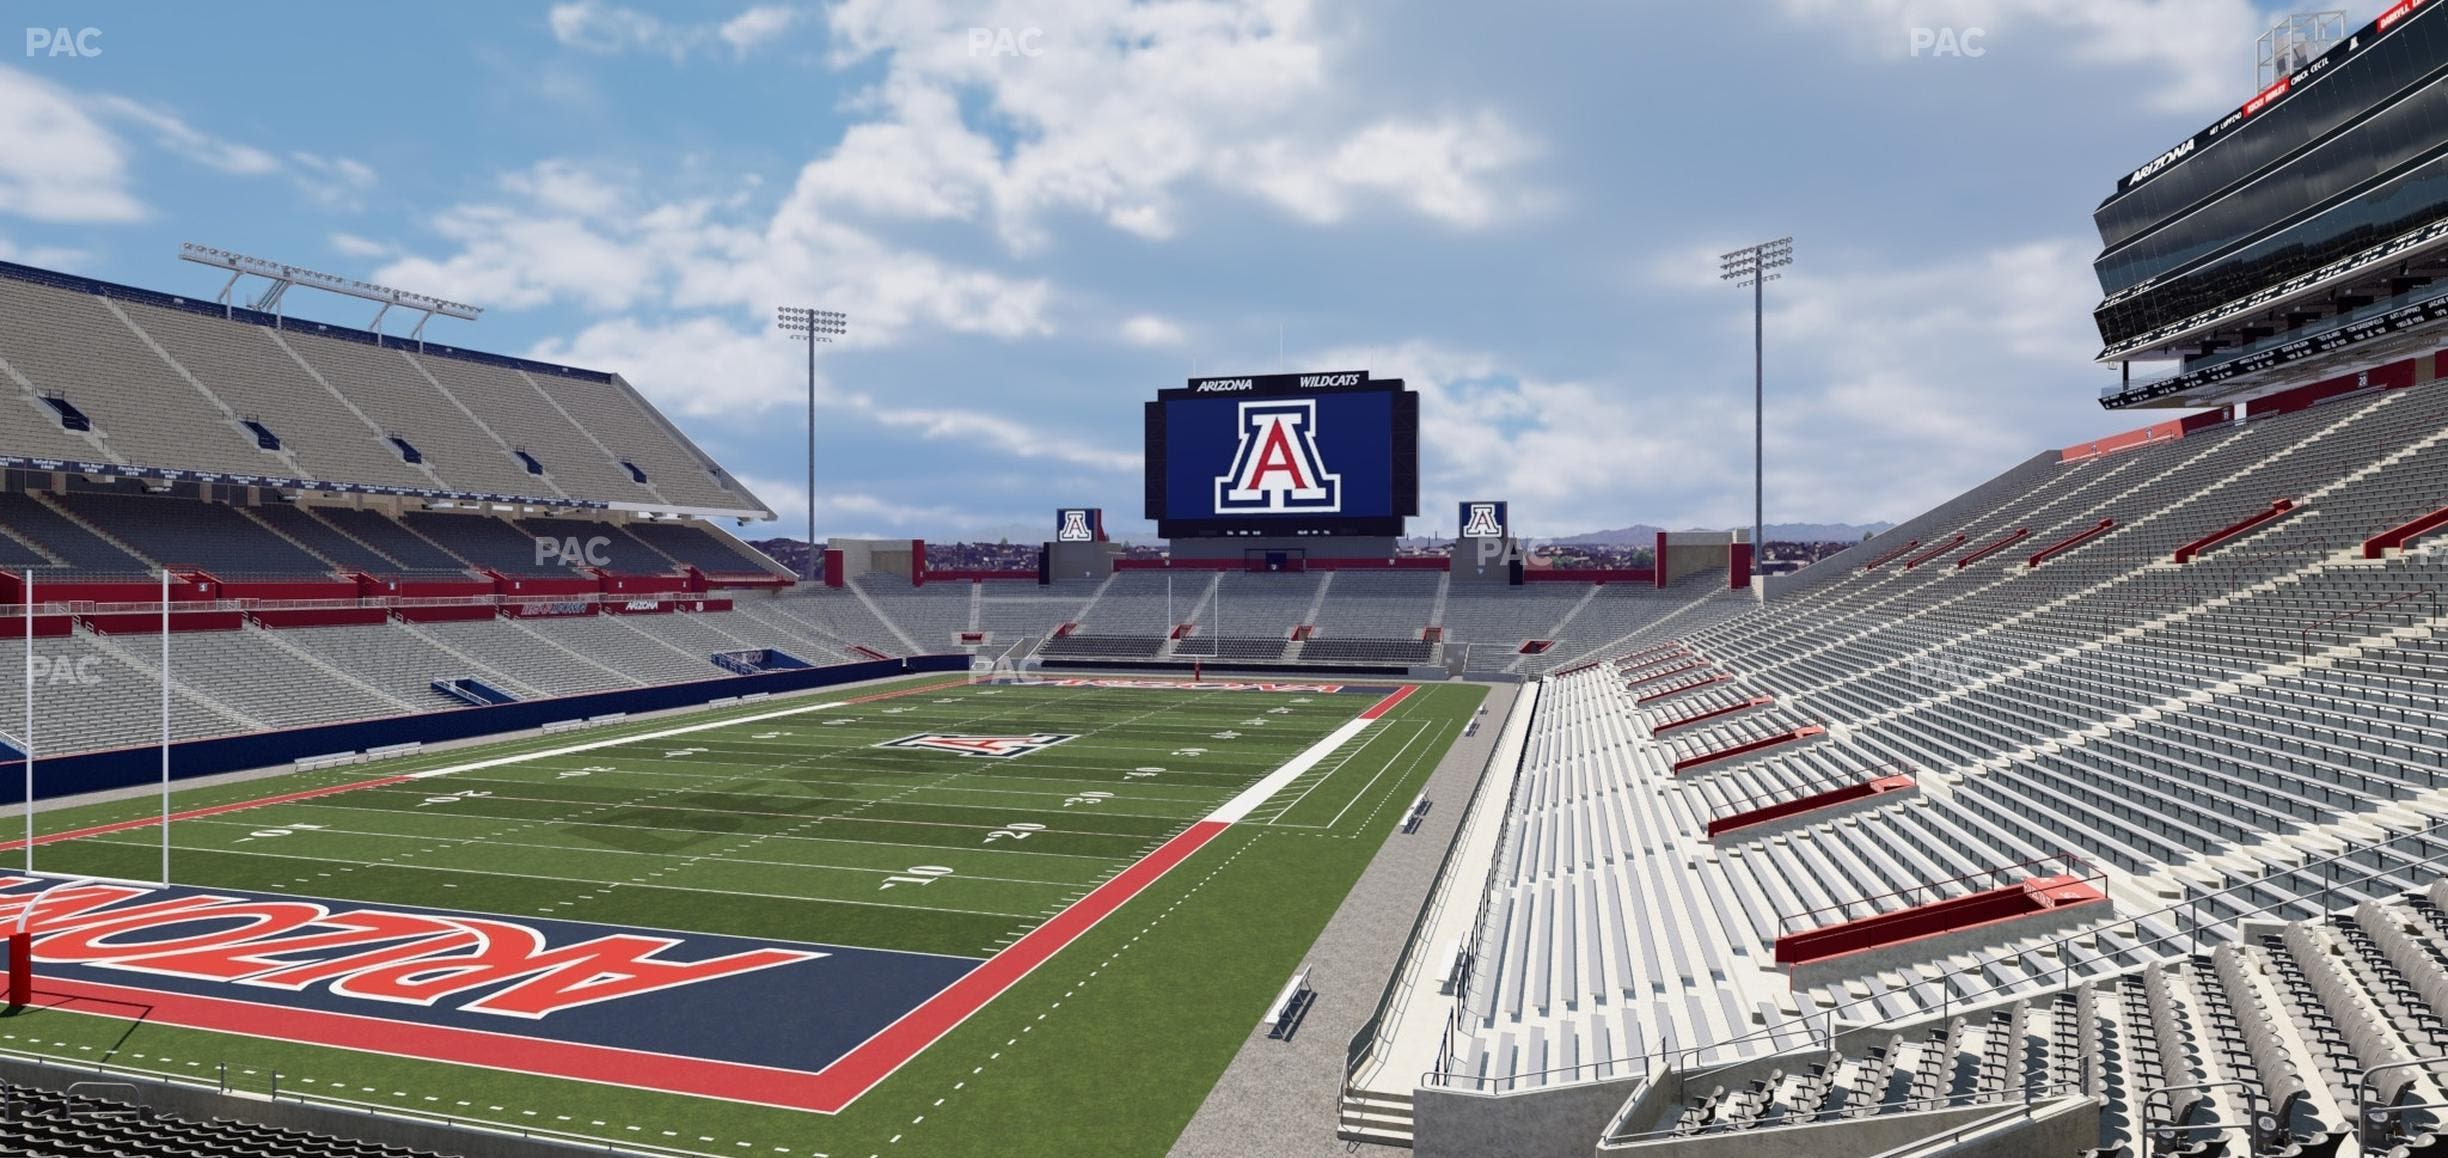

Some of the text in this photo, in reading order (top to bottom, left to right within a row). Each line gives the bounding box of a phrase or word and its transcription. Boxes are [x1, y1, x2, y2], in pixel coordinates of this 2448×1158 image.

[2310, 57, 2329, 74] CECIL
[2128, 138, 2195, 187] ARIZONA
[1197, 374, 1360, 392] ARIZONA WILDCATS
[1214, 398, 1342, 515] A
[1059, 510, 1092, 542] A
[1463, 504, 1502, 538] A
[625, 600, 658, 611] ARIZONA
[1064, 790, 1114, 805] 30
[987, 822, 1046, 840] 20
[882, 865, 954, 886] 10
[0, 876, 830, 1020] ARIZON
